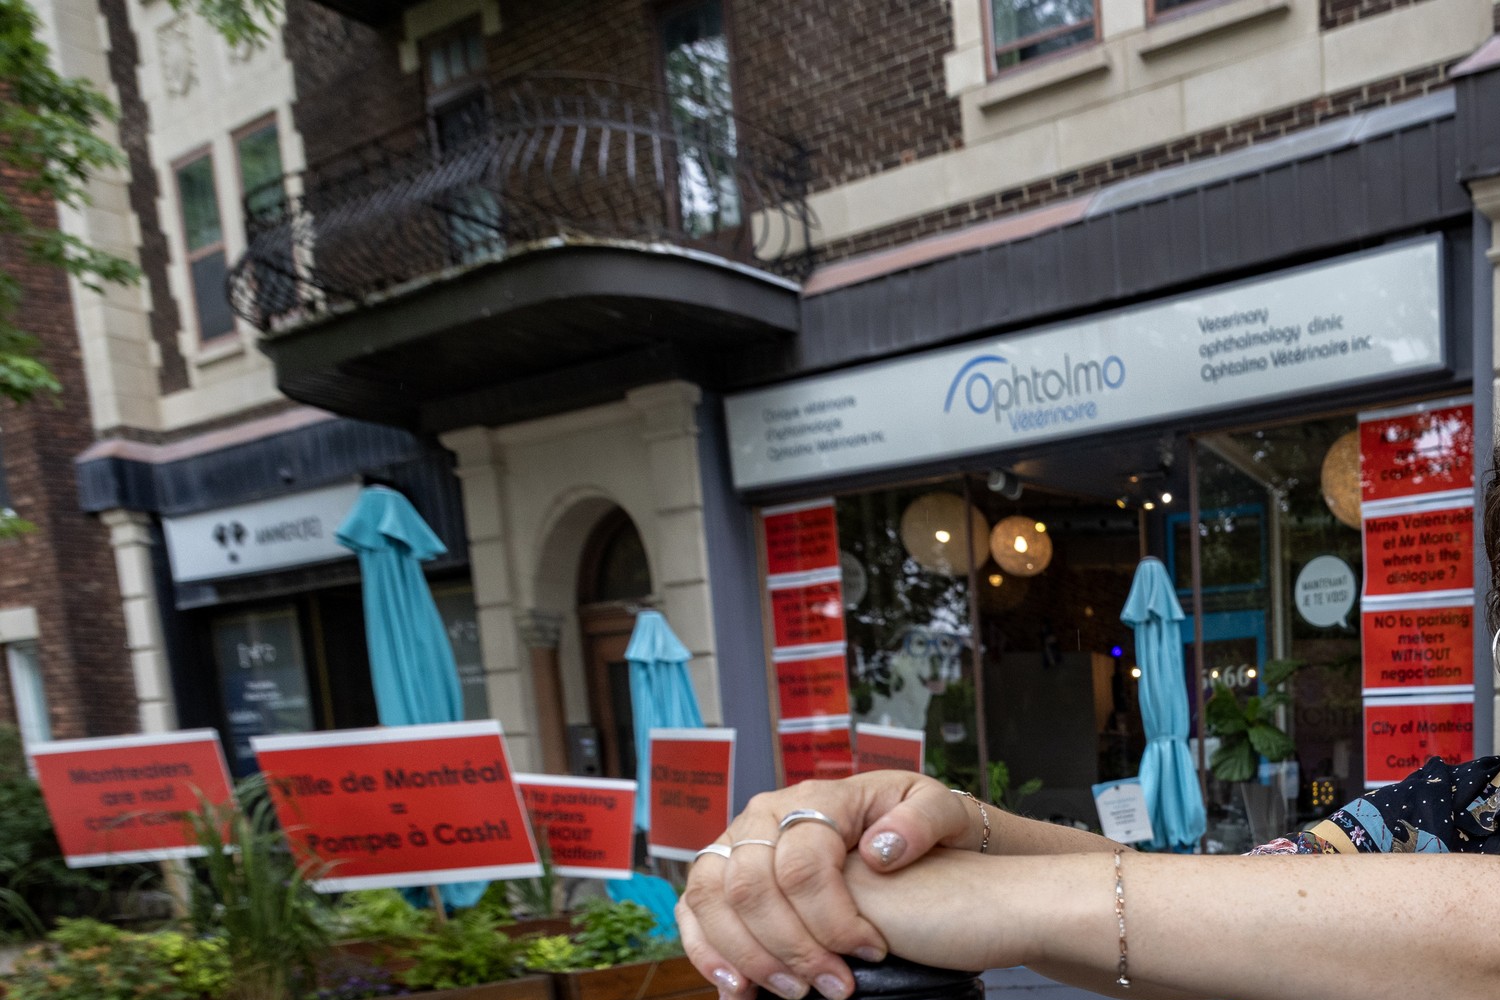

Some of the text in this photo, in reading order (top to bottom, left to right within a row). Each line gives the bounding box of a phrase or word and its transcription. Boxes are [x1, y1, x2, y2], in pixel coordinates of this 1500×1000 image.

[1383, 547, 1461, 568] where is the
[1386, 568, 1446, 585] dialogue
[1374, 612, 1470, 629] NO to parking
[1398, 633, 1445, 645] meters
[1391, 648, 1451, 663] WITHOUT
[1381, 666, 1462, 683] negociation
[1372, 721, 1397, 737] City
[1401, 720, 1413, 734] of
[1386, 755, 1420, 769] Cash
[341, 772, 377, 793] de
[384, 759, 505, 790] Montréal
[307, 820, 511, 854] Pompe à Cash!
